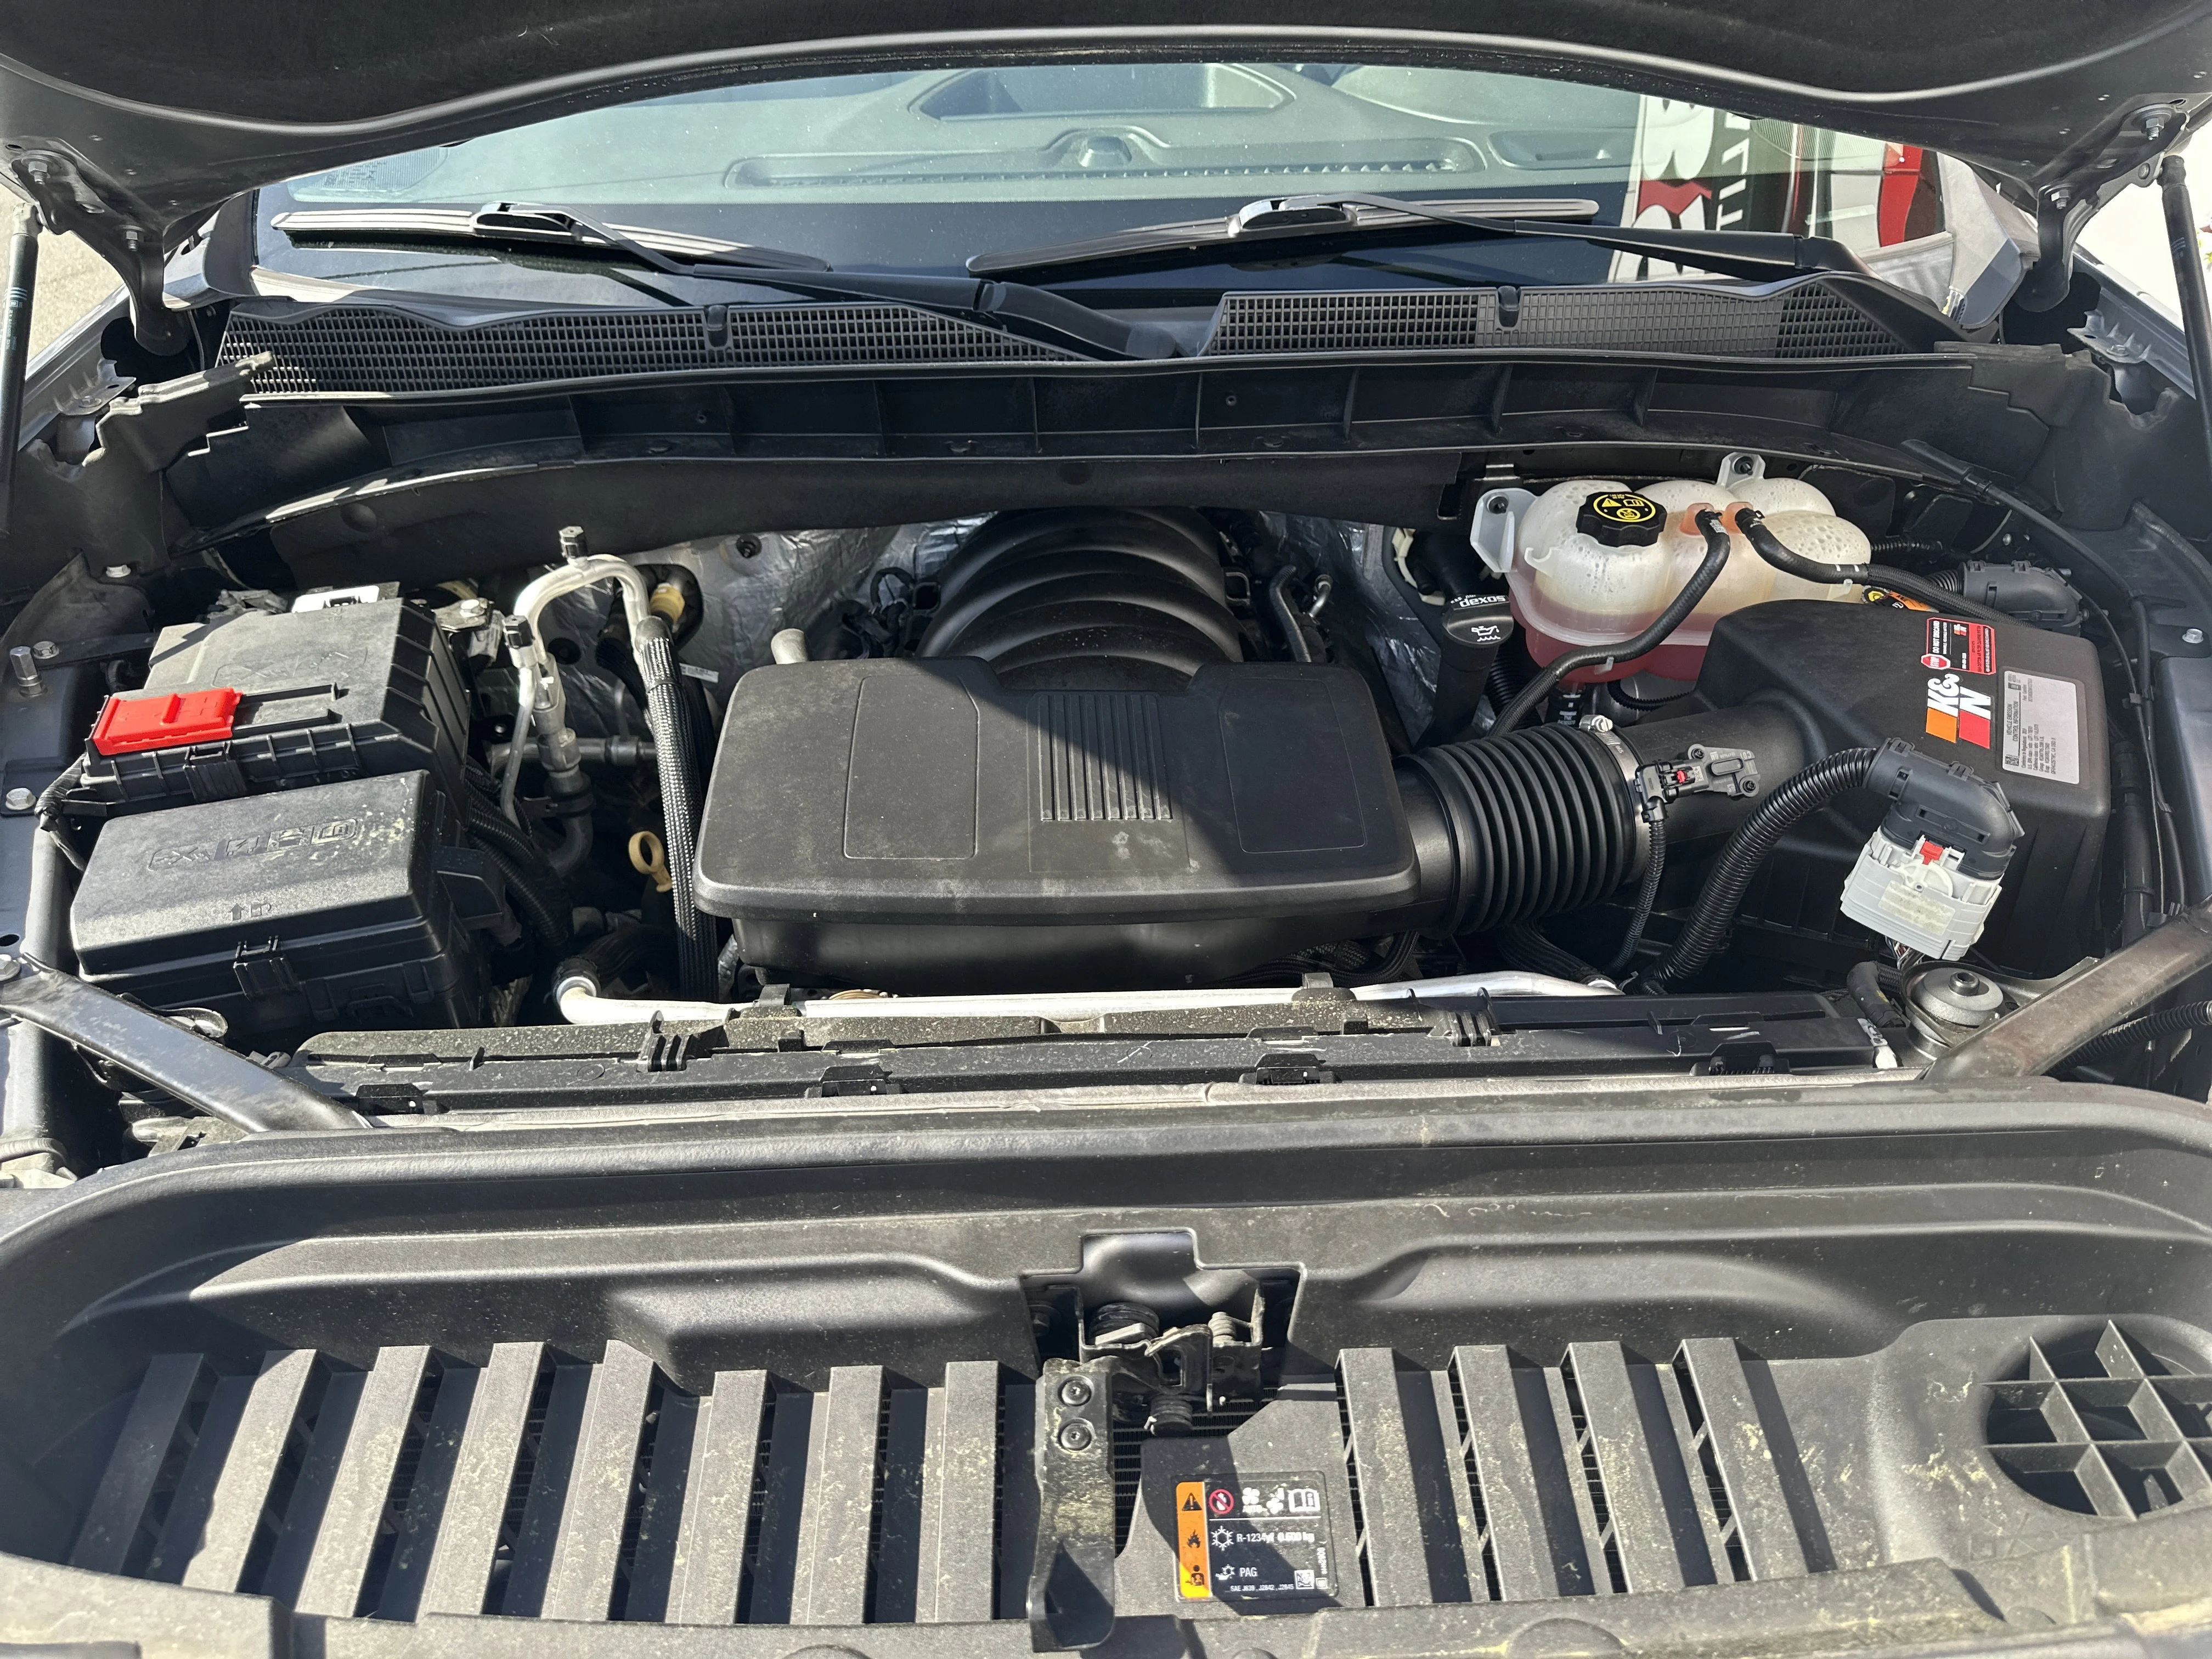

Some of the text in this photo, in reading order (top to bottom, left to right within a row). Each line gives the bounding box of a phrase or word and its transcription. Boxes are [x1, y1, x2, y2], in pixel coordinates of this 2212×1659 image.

[1459, 595, 1506, 607] dexos
[1930, 656, 1939, 668] STOP
[1236, 1532, 1274, 1543] R-1234yf
[1302, 1532, 1315, 1543] kg
[1239, 1566, 1258, 1577] PAG
